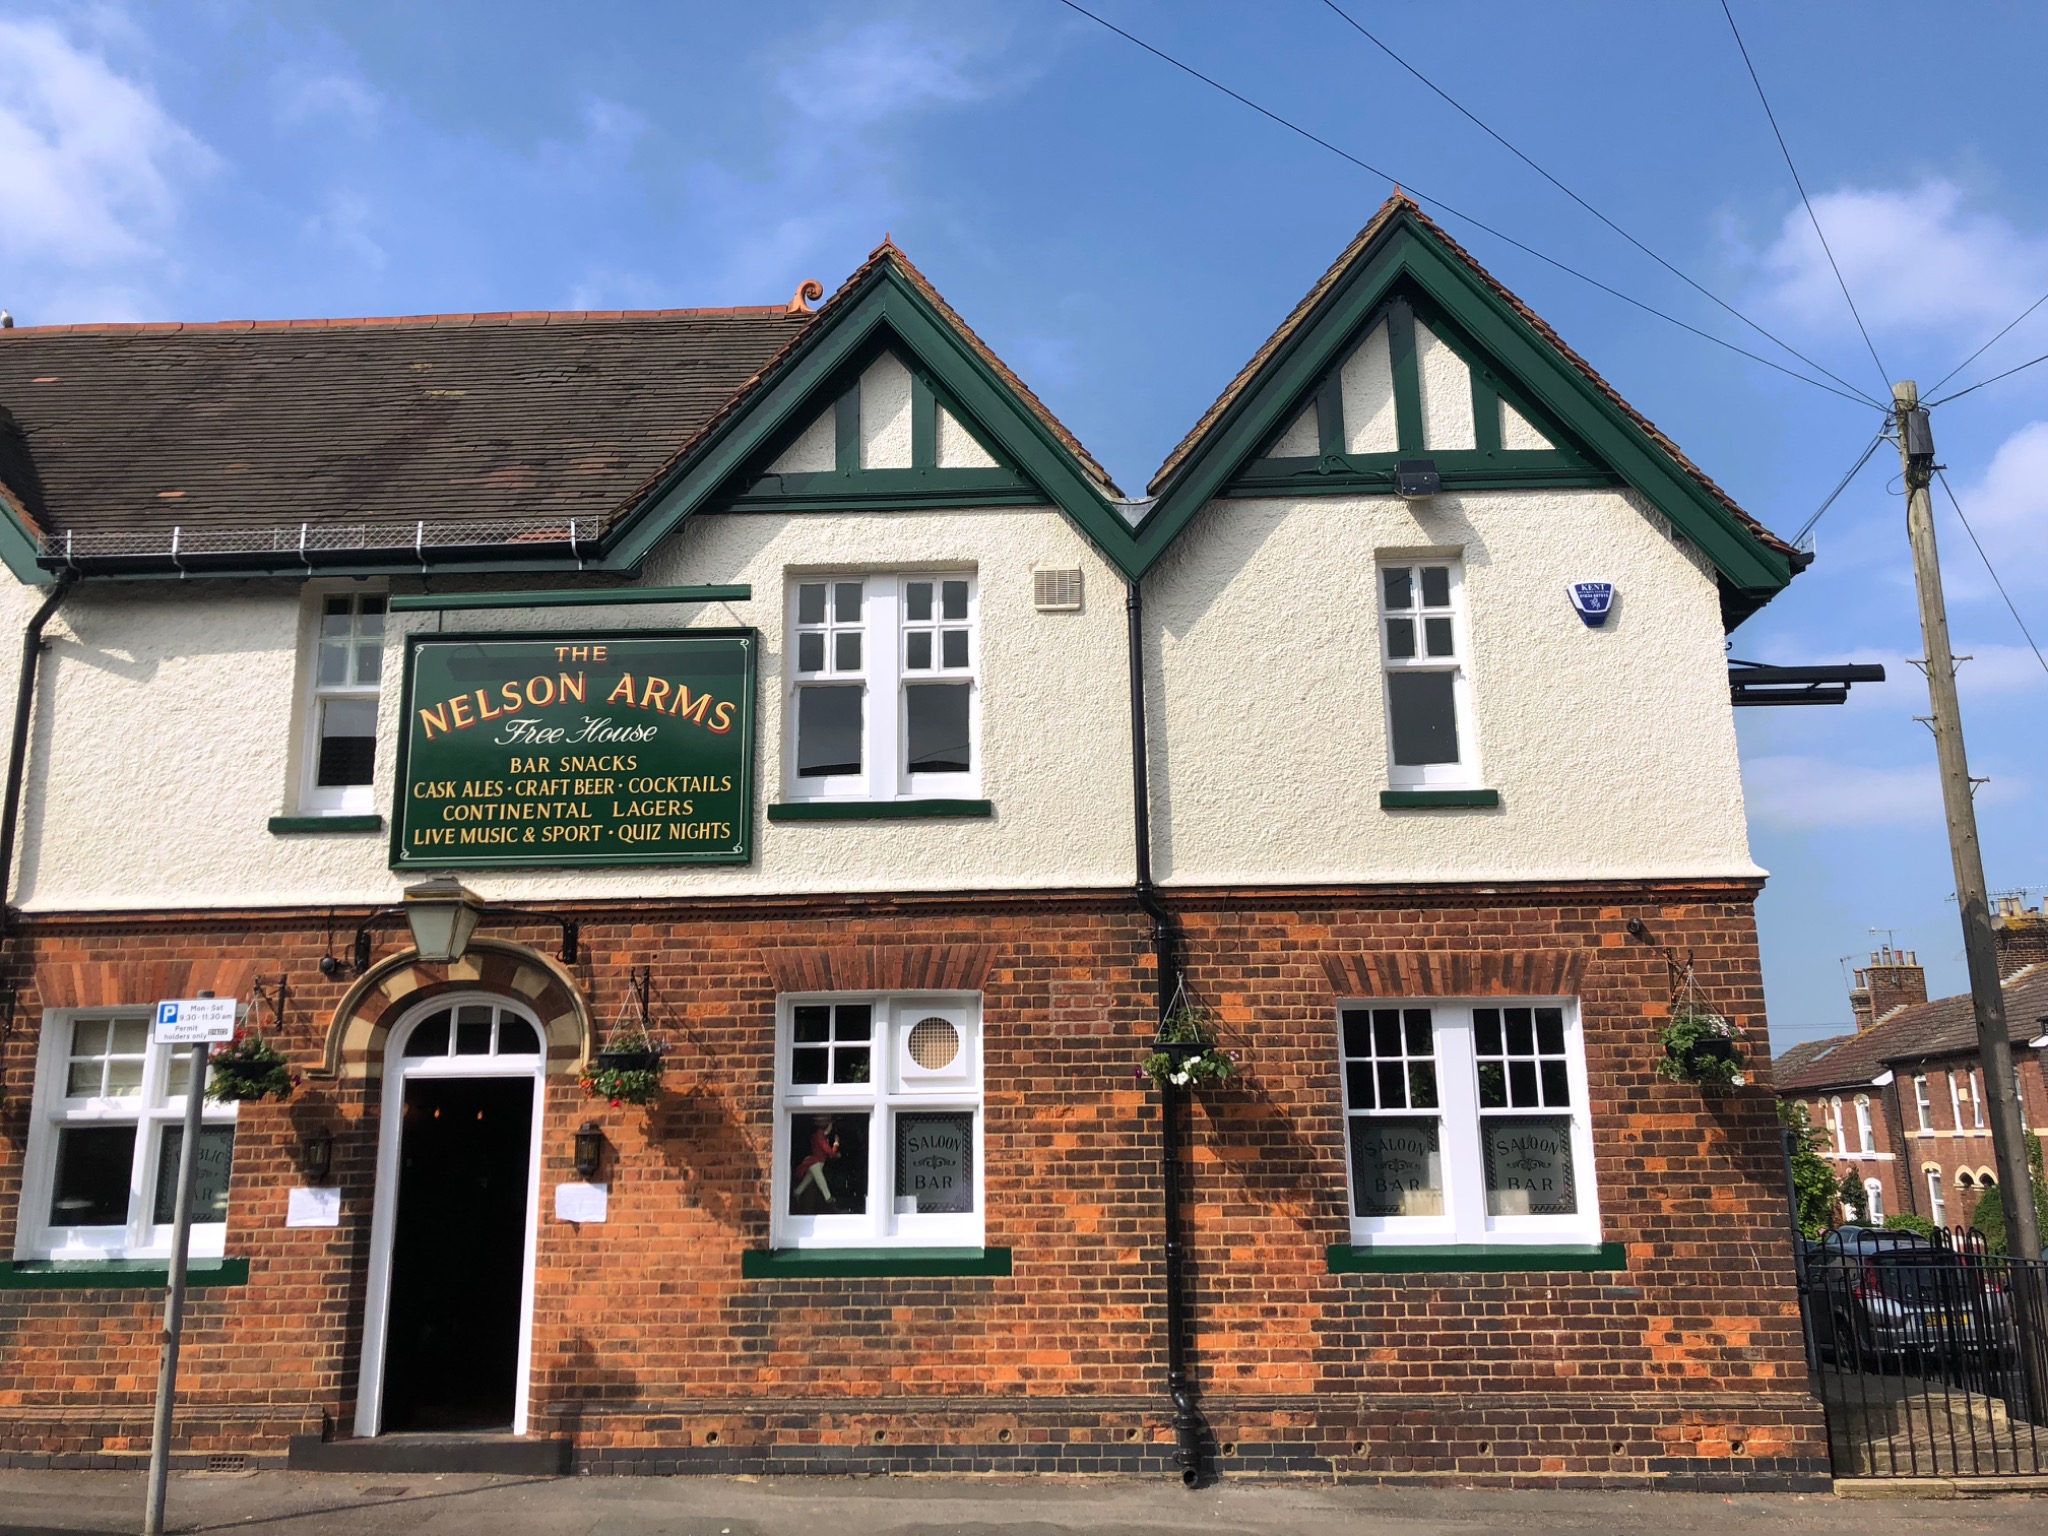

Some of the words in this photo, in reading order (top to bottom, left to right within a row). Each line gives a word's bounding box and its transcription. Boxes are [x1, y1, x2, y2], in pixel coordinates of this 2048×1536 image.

[554, 646, 609, 663] THE
[418, 670, 587, 740] NELSON
[607, 672, 738, 735] ARMS
[494, 718, 563, 746] Free
[565, 715, 658, 744] House
[510, 757, 550, 774] BAR
[560, 755, 638, 772] SNACKS
[413, 781, 457, 799] CASK
[461, 780, 503, 798] ALES
[515, 778, 571, 796] CRAFT
[574, 778, 615, 795] BEER
[628, 775, 731, 793] COCKTAILS
[443, 802, 592, 821] CONTINENTAL
[612, 799, 694, 818] LAGERS
[413, 828, 455, 845] LIVE
[460, 826, 518, 844] MUSIC
[522, 828, 536, 843] &
[541, 825, 603, 842] SPORT
[618, 824, 661, 843] QUIZ
[668, 822, 731, 840] NIGHTS
[163, 1006, 176, 1022] P
[908, 1134, 961, 1152] SALOON
[1365, 1138, 1425, 1157] SALOON
[1496, 1136, 1559, 1156] SALOON
[915, 1175, 953, 1190] BAR
[1375, 1178, 1420, 1193] BAR
[1508, 1177, 1553, 1191] BAR
